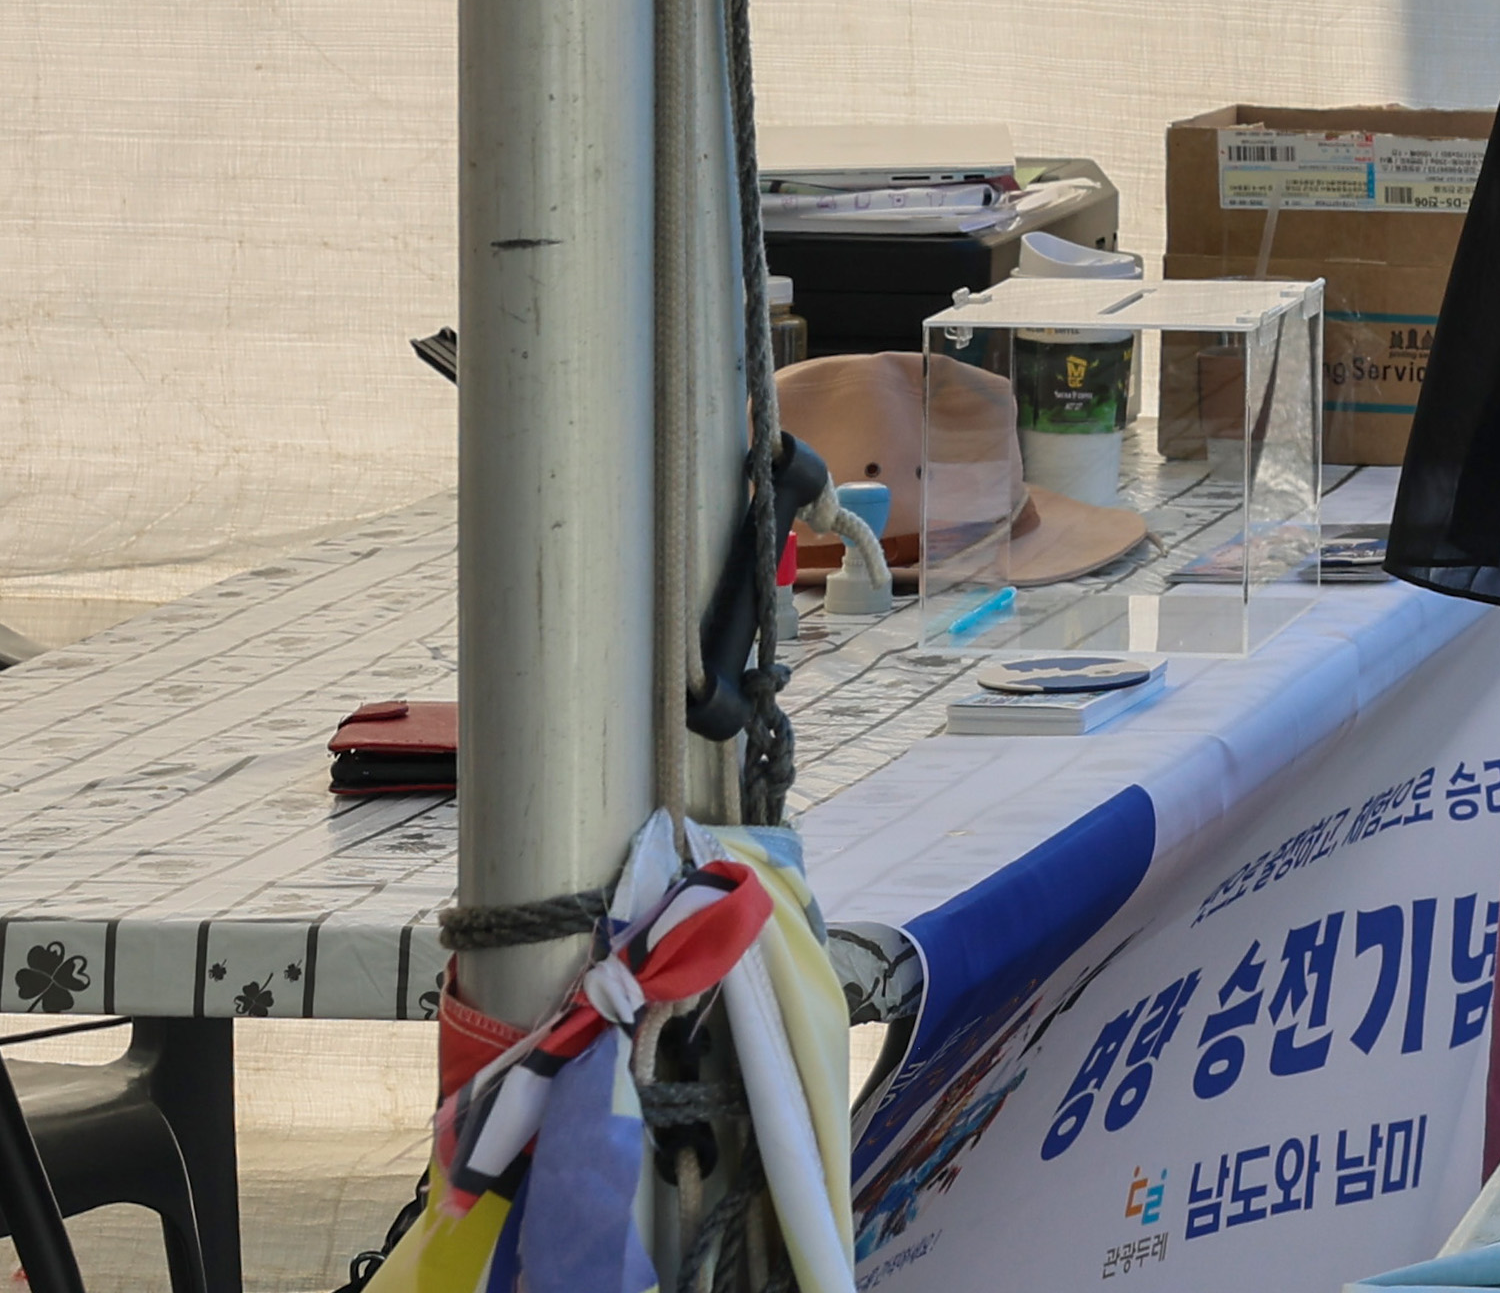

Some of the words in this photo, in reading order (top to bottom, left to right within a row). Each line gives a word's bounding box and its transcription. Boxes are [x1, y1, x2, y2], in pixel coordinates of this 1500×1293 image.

[1041, 968, 1201, 1161] 명량
[1185, 1133, 1320, 1241] 남도와
[1335, 1114, 1428, 1206] 남미
[1101, 1231, 1169, 1280] 관광두레
